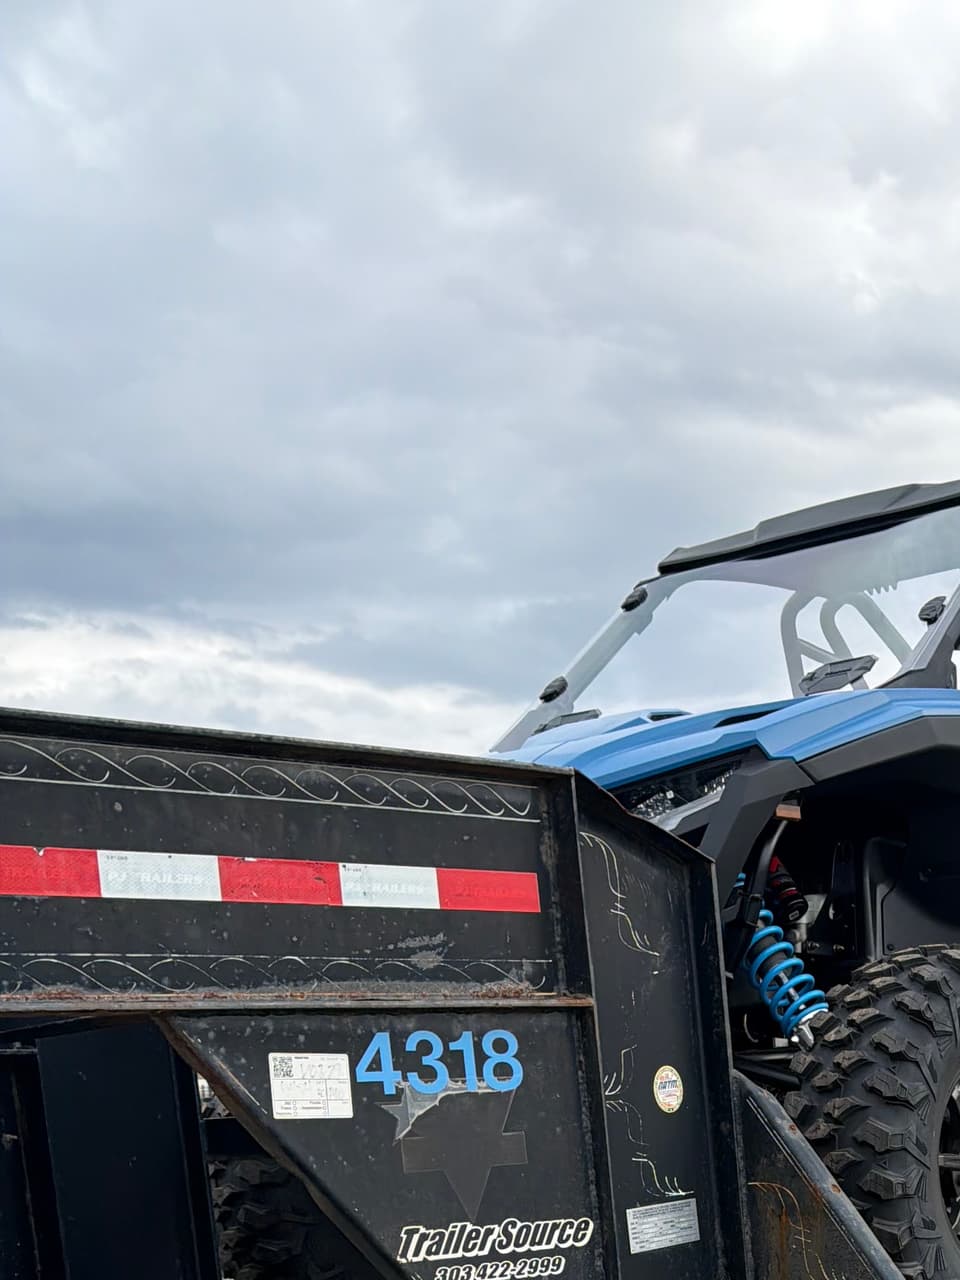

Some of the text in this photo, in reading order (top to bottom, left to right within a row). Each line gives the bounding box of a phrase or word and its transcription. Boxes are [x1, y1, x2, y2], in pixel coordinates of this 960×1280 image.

[355, 1029, 524, 1096] 4318
[397, 1221, 500, 1264] Trailer
[495, 1217, 594, 1255] Source
